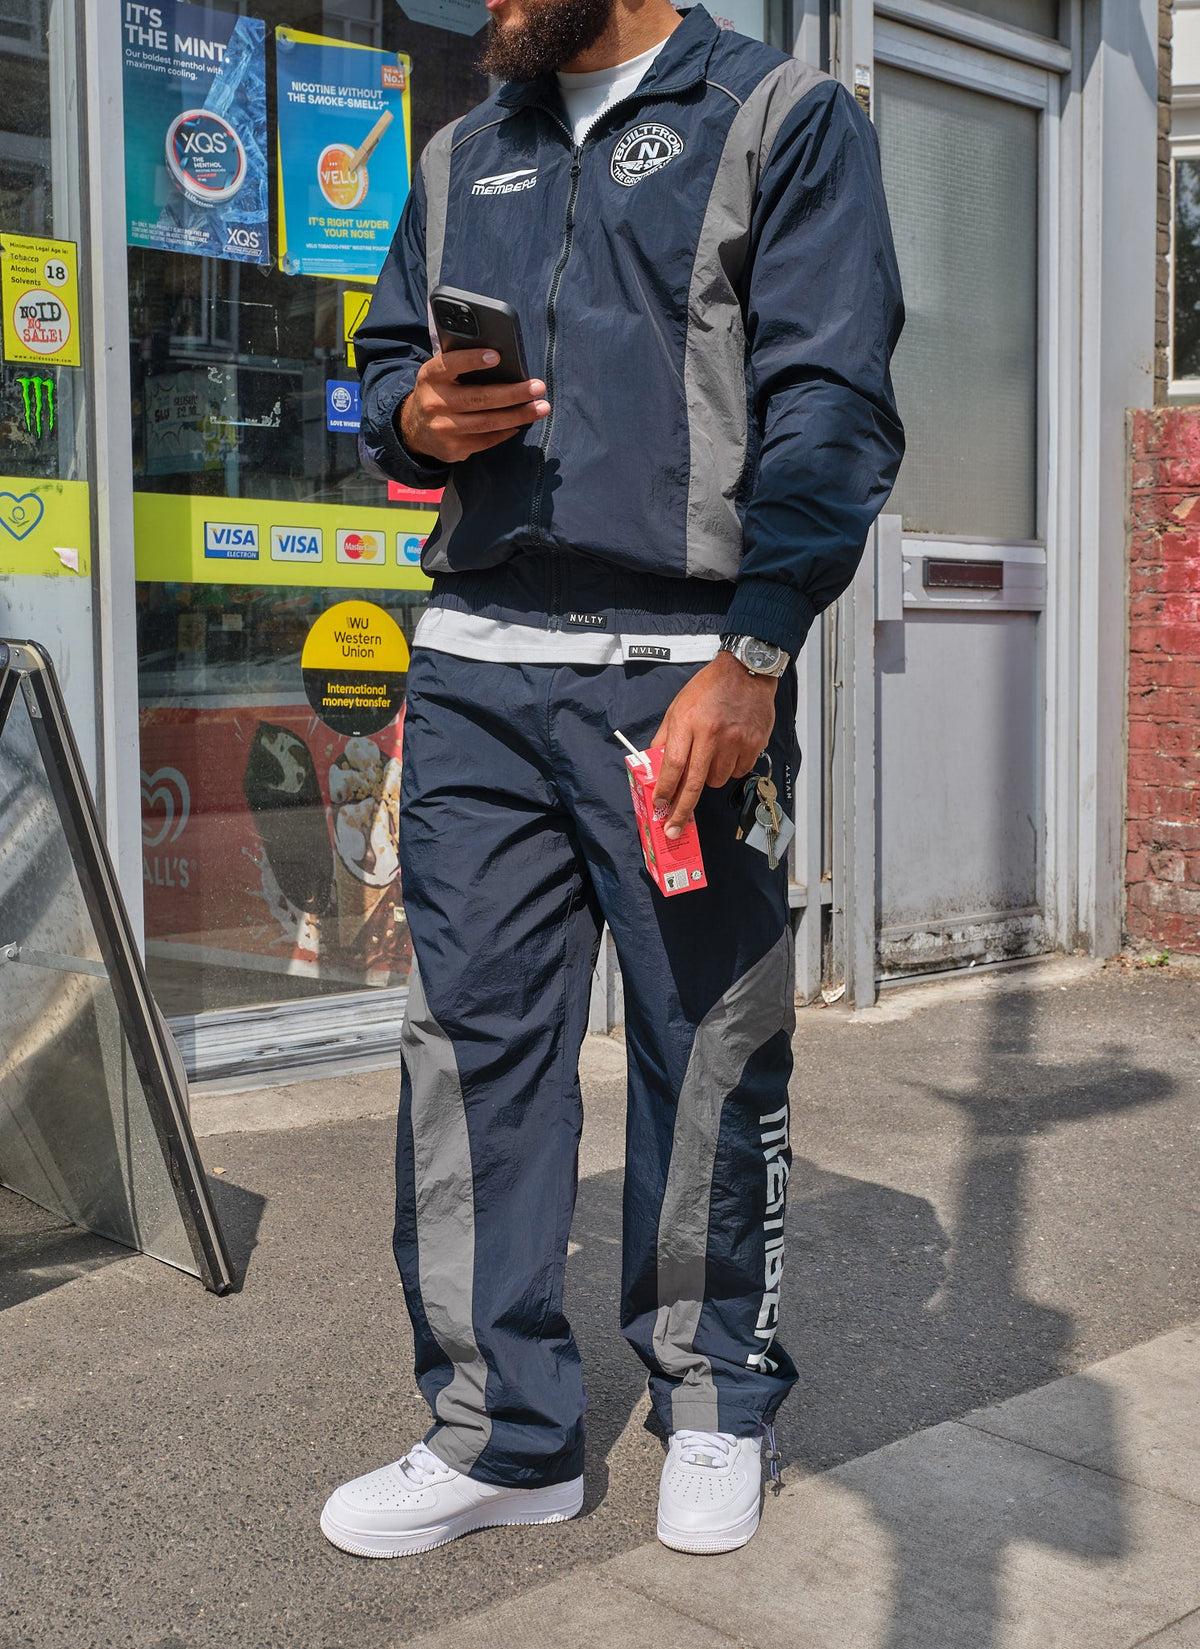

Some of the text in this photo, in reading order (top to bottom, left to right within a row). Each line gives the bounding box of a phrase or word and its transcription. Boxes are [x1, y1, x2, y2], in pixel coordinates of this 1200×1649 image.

[126, 2, 163, 28] IT'S
[124, 23, 230, 64] THE MINT.
[125, 48, 223, 75] Our boldest menthol with
[126, 59, 198, 81] maximum cooling.
[384, 73, 404, 84] No.1
[291, 81, 383, 99] NICOTINE WITHOUT
[287, 92, 306, 103] THE
[181, 132, 227, 154] XQS
[614, 126, 682, 160] BUILT FROM
[638, 142, 660, 160] N
[321, 170, 358, 185] VELO
[613, 165, 625, 181] THE
[471, 175, 537, 195] MEMBERS
[308, 217, 389, 230] IT'S RIGHT UNDER
[226, 228, 260, 248] XQS
[323, 228, 376, 239] YOUR NOSE
[10, 242, 34, 250] Minimum
[51, 247, 60, 255] Age
[10, 253, 40, 263] Tobacco
[10, 265, 37, 274] Alcohol
[47, 265, 66, 280] 18
[11, 276, 42, 286] Solvents
[19, 302, 62, 322] NO ID
[27, 317, 41, 330] NO
[23, 329, 63, 343] SALE!
[330, 419, 343, 428] LOVE
[209, 527, 256, 546] VISA
[275, 533, 319, 554] VISA
[345, 542, 380, 552] MasterCard
[226, 550, 257, 559] ELECTRON
[349, 617, 369, 630] WU
[569, 614, 604, 624] NVLTY
[334, 631, 382, 645] Western
[342, 645, 374, 658] Union
[631, 646, 667, 656] NVLTY
[327, 682, 387, 695] International
[322, 697, 391, 709] money transfer
[785, 764, 793, 799] NVLTY
[143, 856, 190, 888] ALL'S
